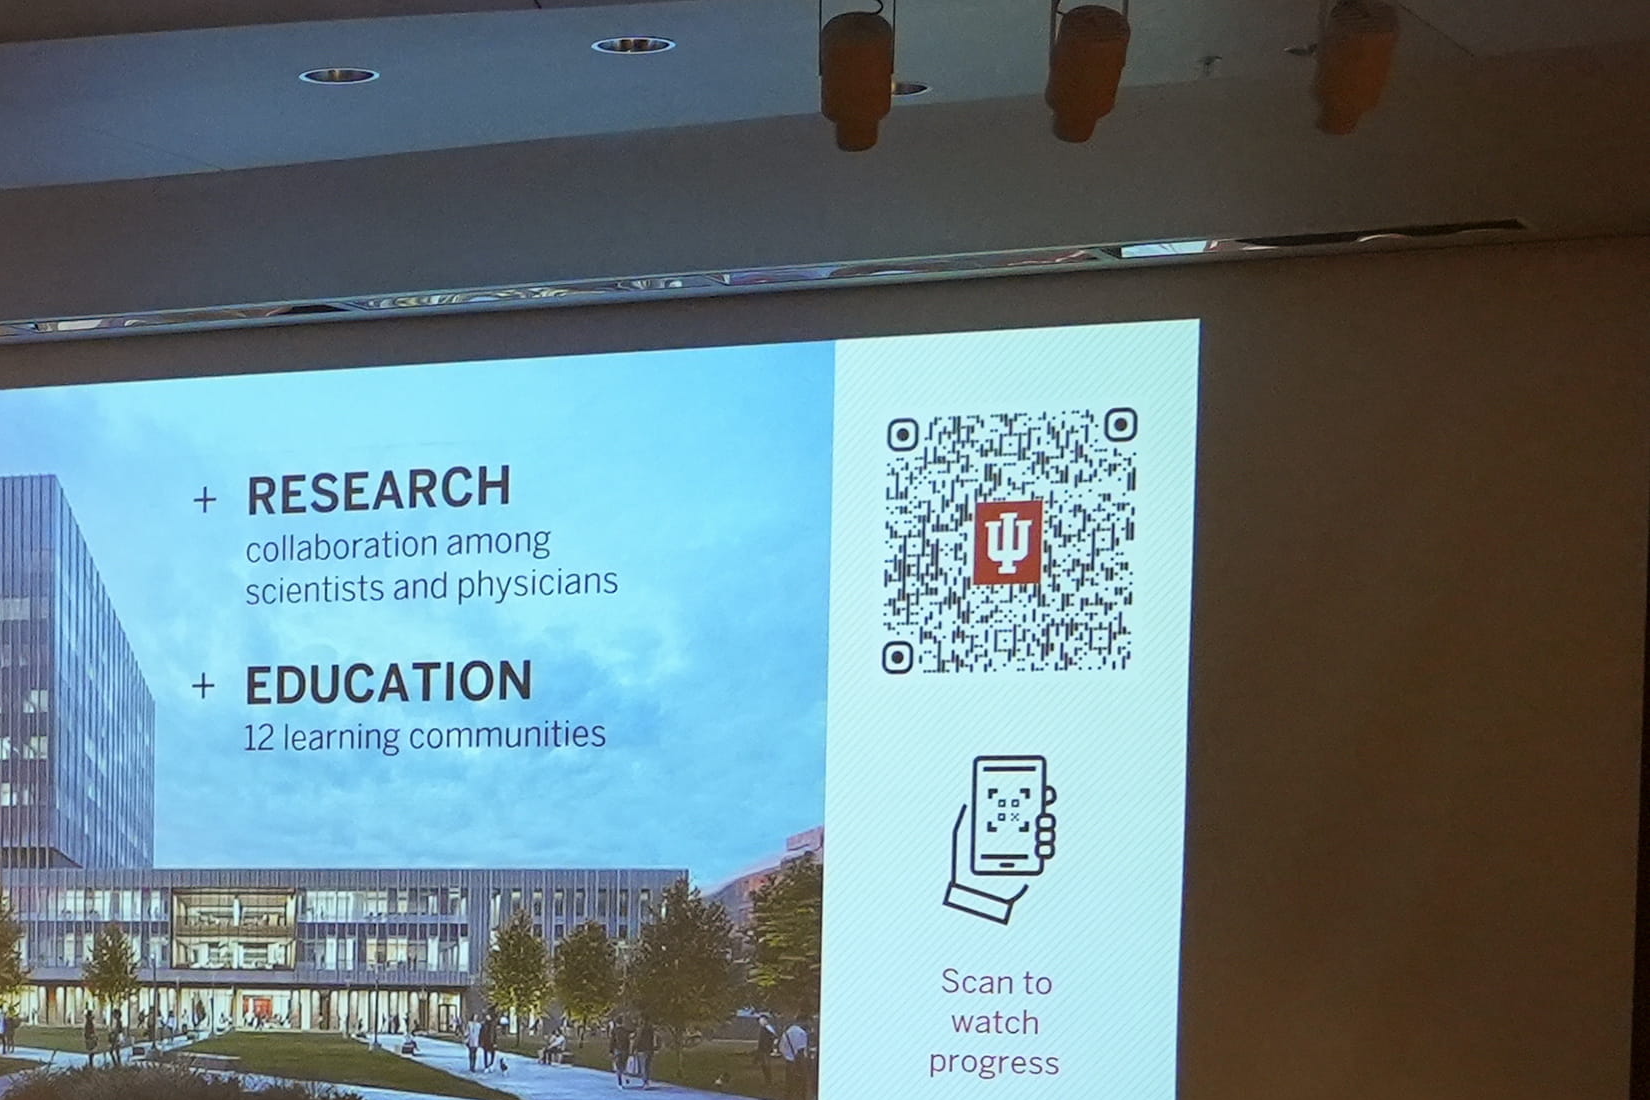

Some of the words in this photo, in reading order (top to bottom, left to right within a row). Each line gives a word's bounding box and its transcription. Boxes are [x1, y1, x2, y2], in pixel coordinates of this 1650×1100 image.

[248, 464, 510, 516] RESEARCH
[246, 529, 438, 564] collaboration
[446, 530, 552, 560] among
[245, 574, 385, 606] scientists
[393, 570, 448, 601] and
[457, 567, 619, 606] physicians
[246, 659, 532, 706] EDUCATION
[243, 722, 275, 752] 12
[284, 722, 401, 757] learning
[409, 719, 607, 750] communities
[941, 967, 1014, 995] Scan
[1022, 970, 1053, 996] to
[951, 1008, 1039, 1035] watch
[929, 1053, 1060, 1080] progress
